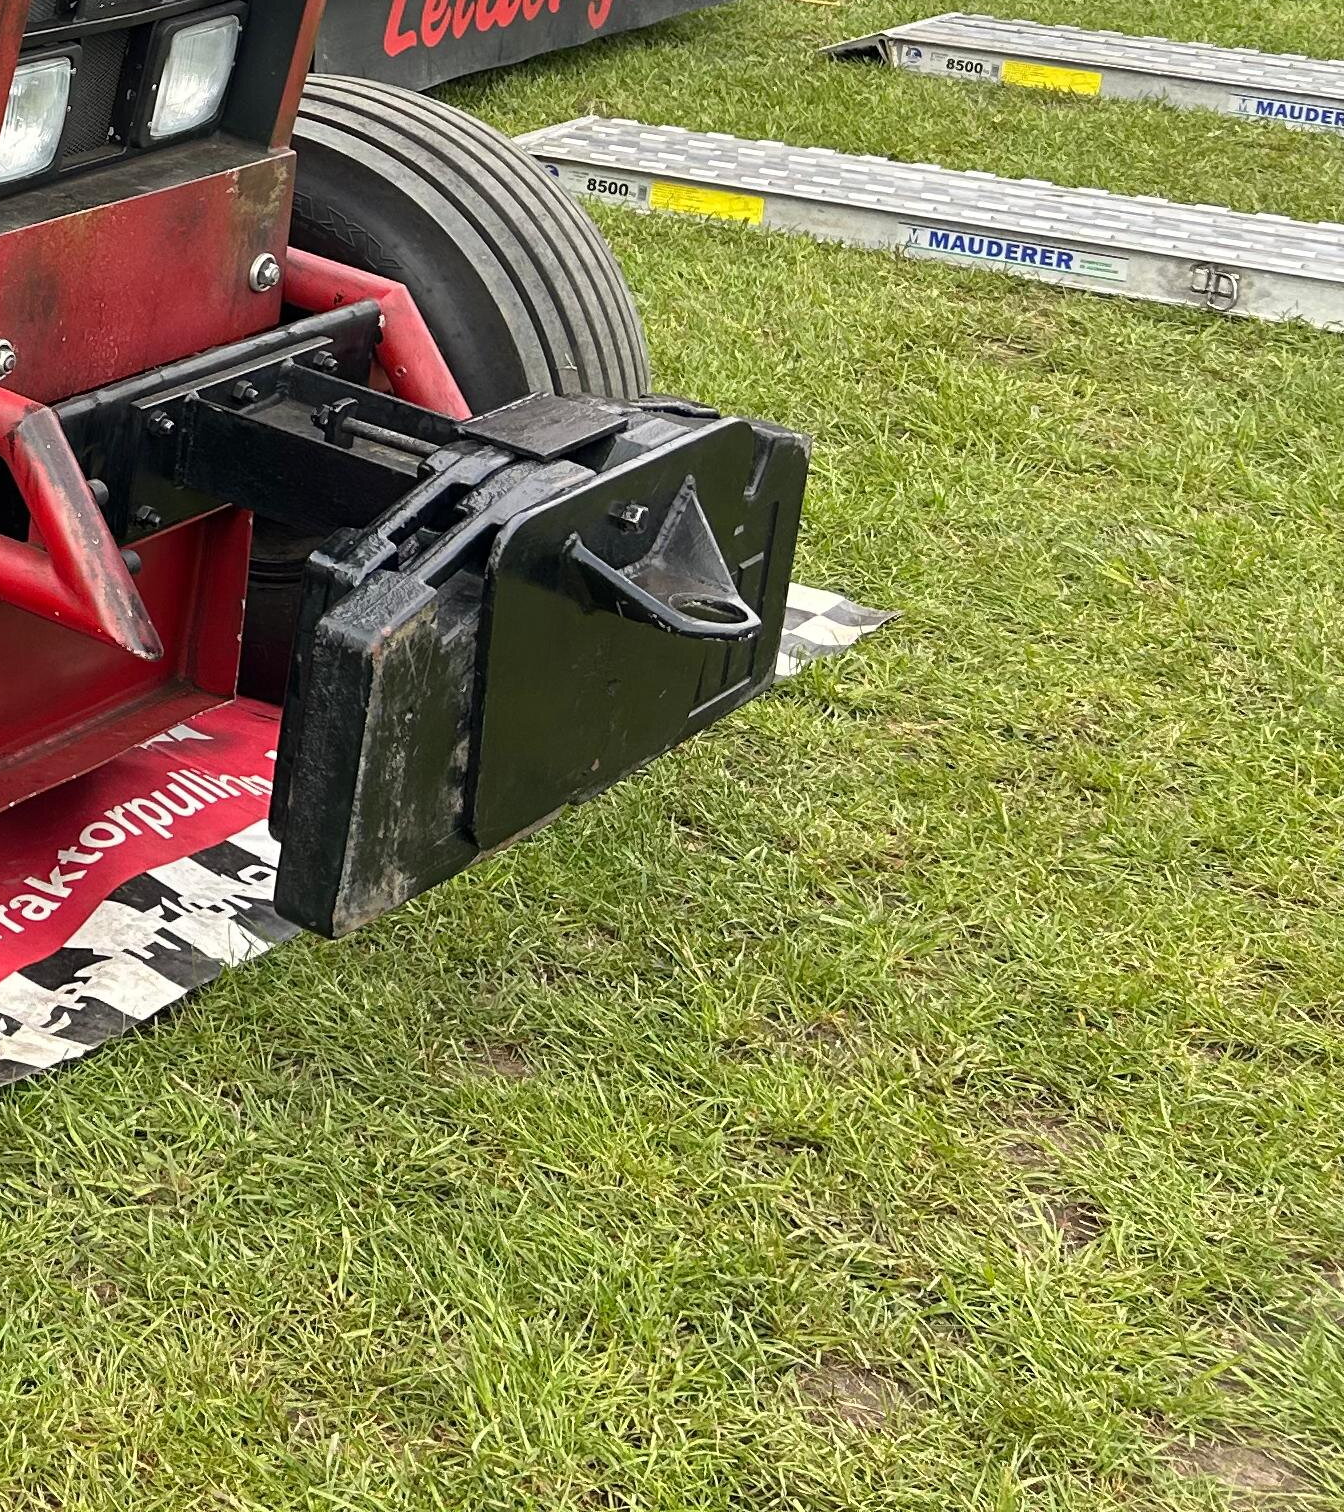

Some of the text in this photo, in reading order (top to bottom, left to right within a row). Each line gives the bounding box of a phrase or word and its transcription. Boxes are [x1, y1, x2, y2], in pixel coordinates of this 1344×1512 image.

[946, 58, 983, 75] 8500
[1255, 101, 1344, 127] MAUDER
[586, 178, 629, 197] 8500
[928, 231, 1074, 270] MAUDERER
